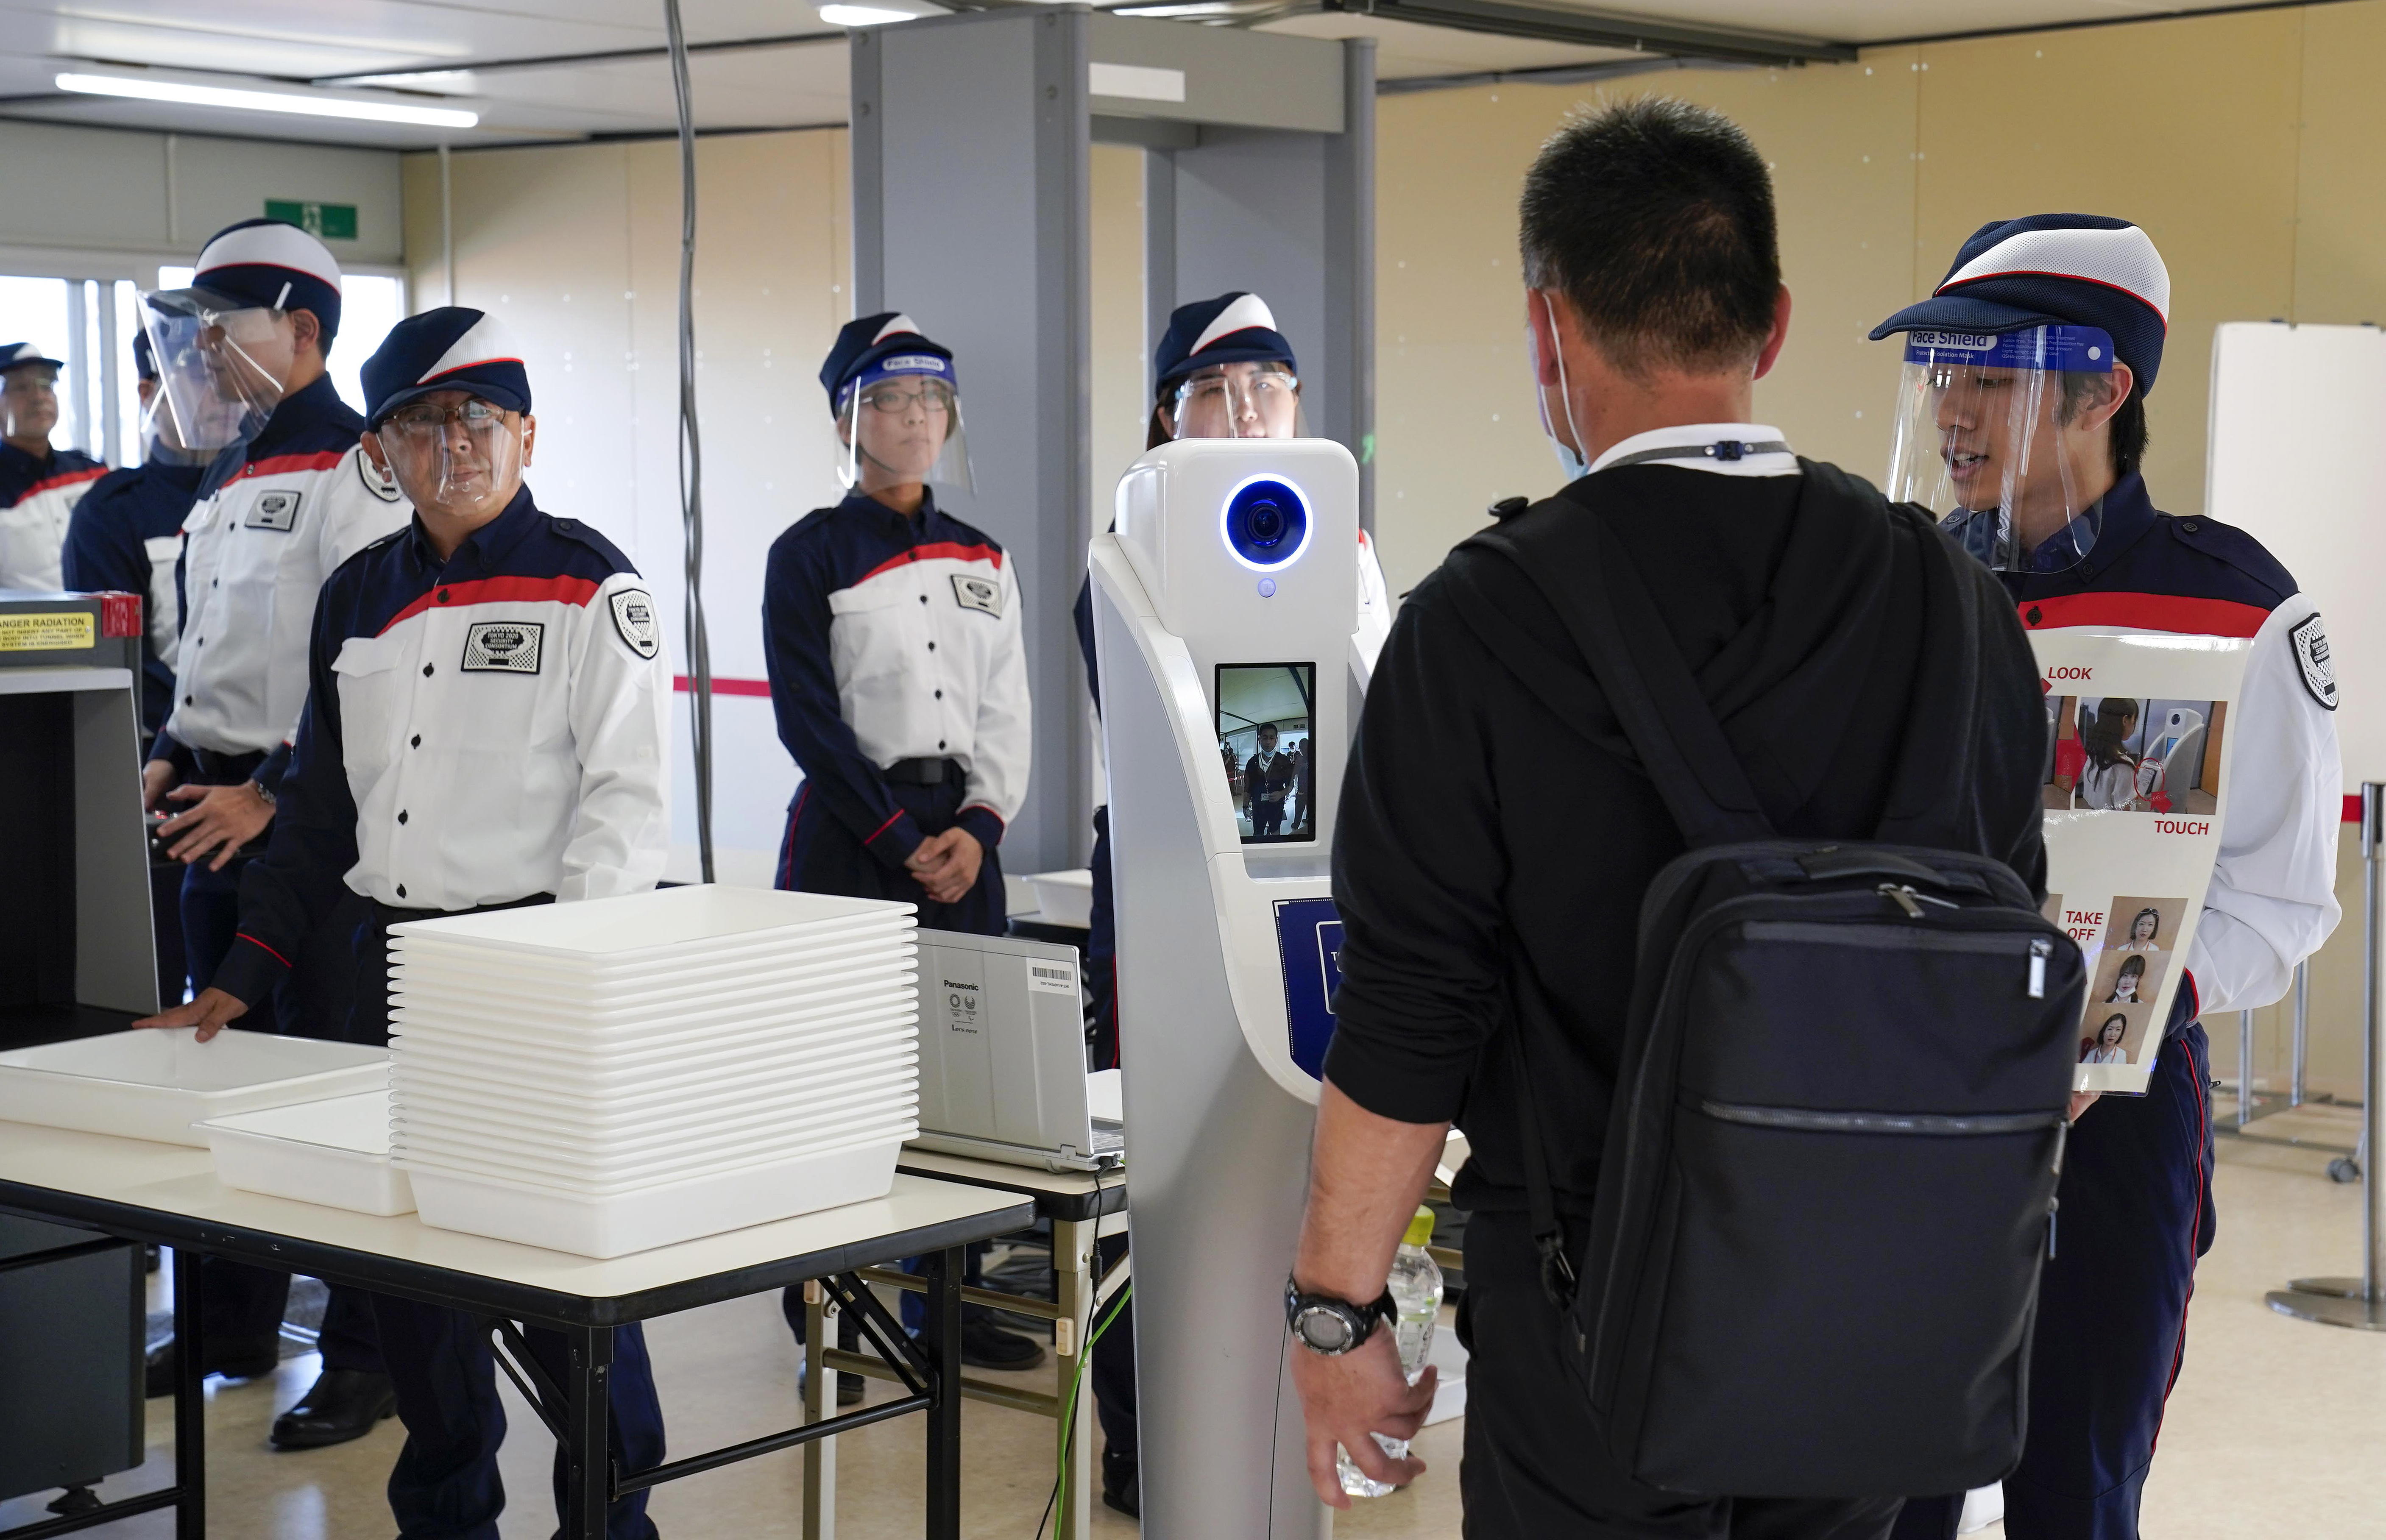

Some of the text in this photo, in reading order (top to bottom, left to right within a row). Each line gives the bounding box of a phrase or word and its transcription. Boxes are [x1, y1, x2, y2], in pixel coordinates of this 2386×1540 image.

[1912, 331, 1987, 347] Face Shield
[33, 617, 84, 627] RADIATION
[2048, 667, 2093, 679] LOOK
[2154, 820, 2209, 835] TOUCH
[2066, 911, 2103, 925] TAKE
[2067, 928, 2096, 941] OFF
[944, 980, 979, 991] Panasonic
